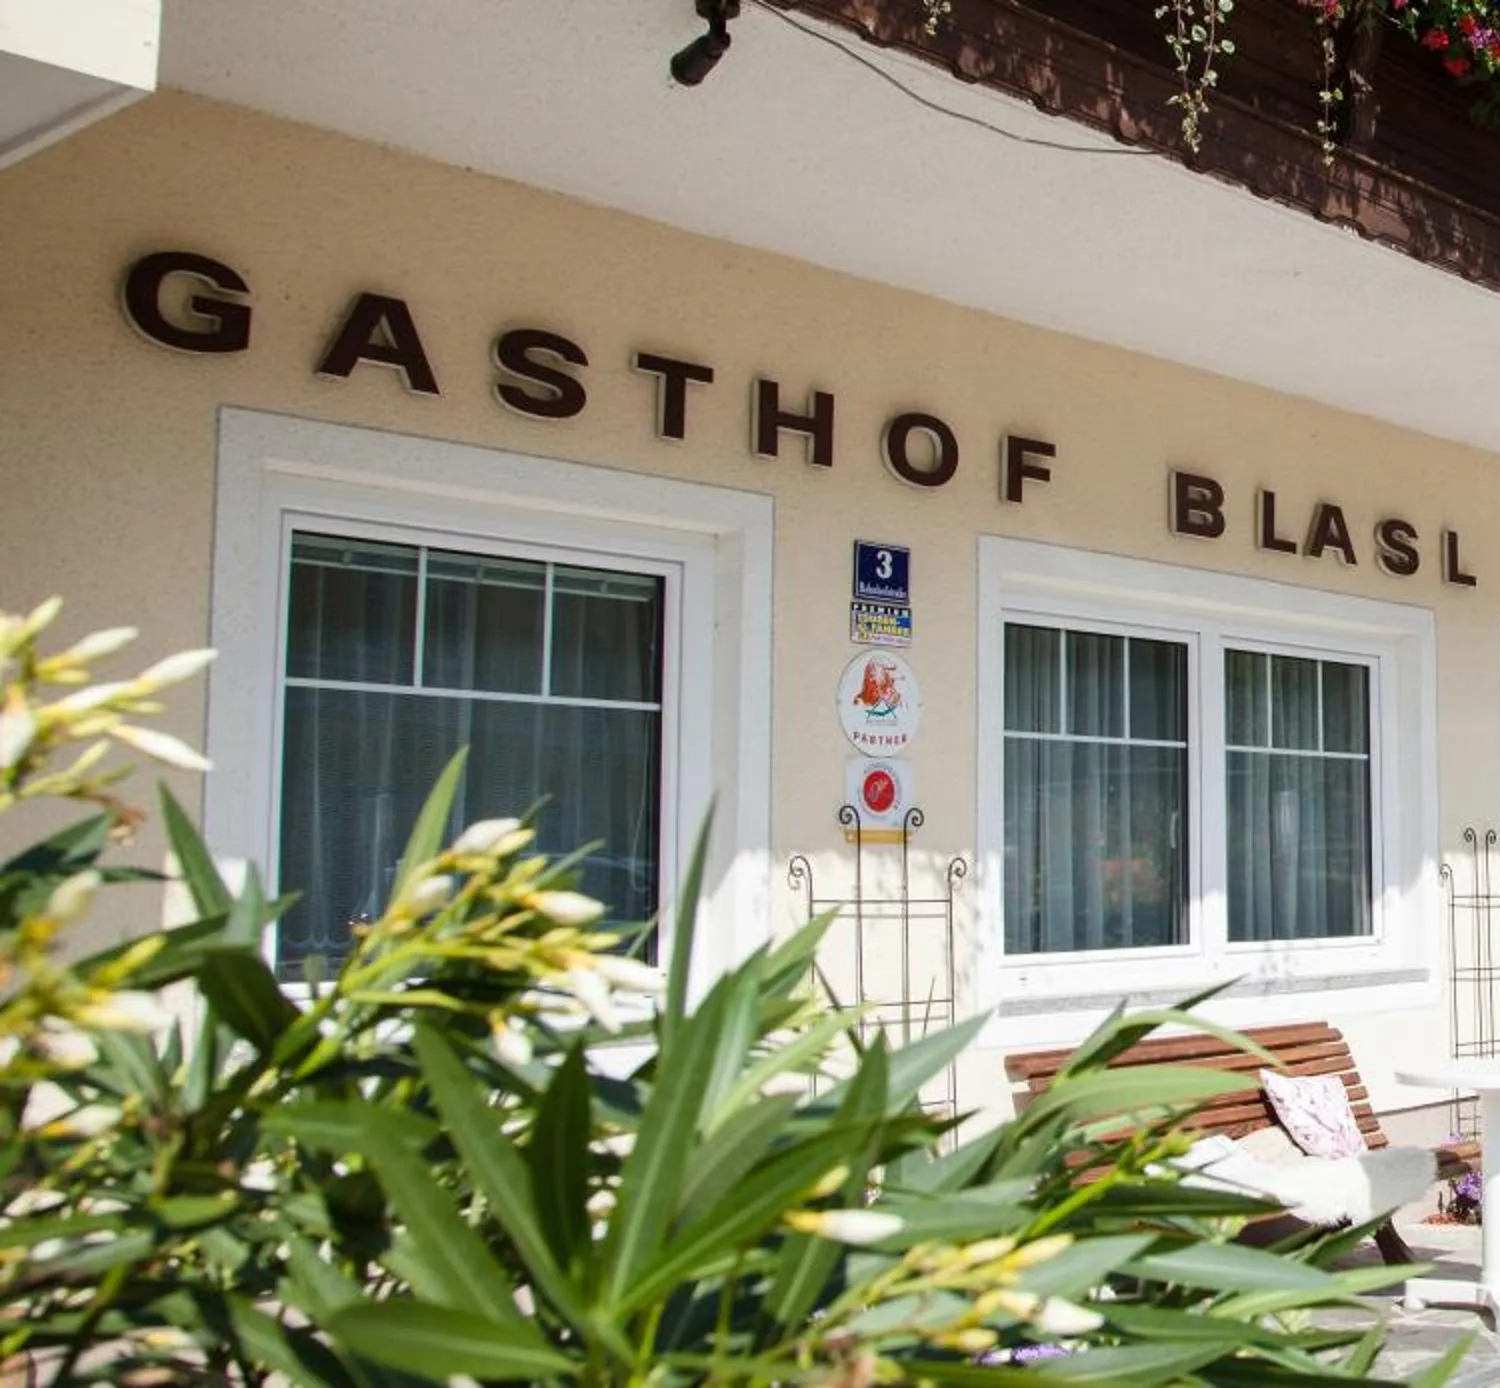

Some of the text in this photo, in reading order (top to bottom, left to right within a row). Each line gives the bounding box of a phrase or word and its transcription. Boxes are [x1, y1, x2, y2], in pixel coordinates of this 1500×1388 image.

[122, 250, 1478, 587] GASTHOF BLASL
[876, 550, 893, 579] 3
[853, 731, 907, 746] PARTNER
